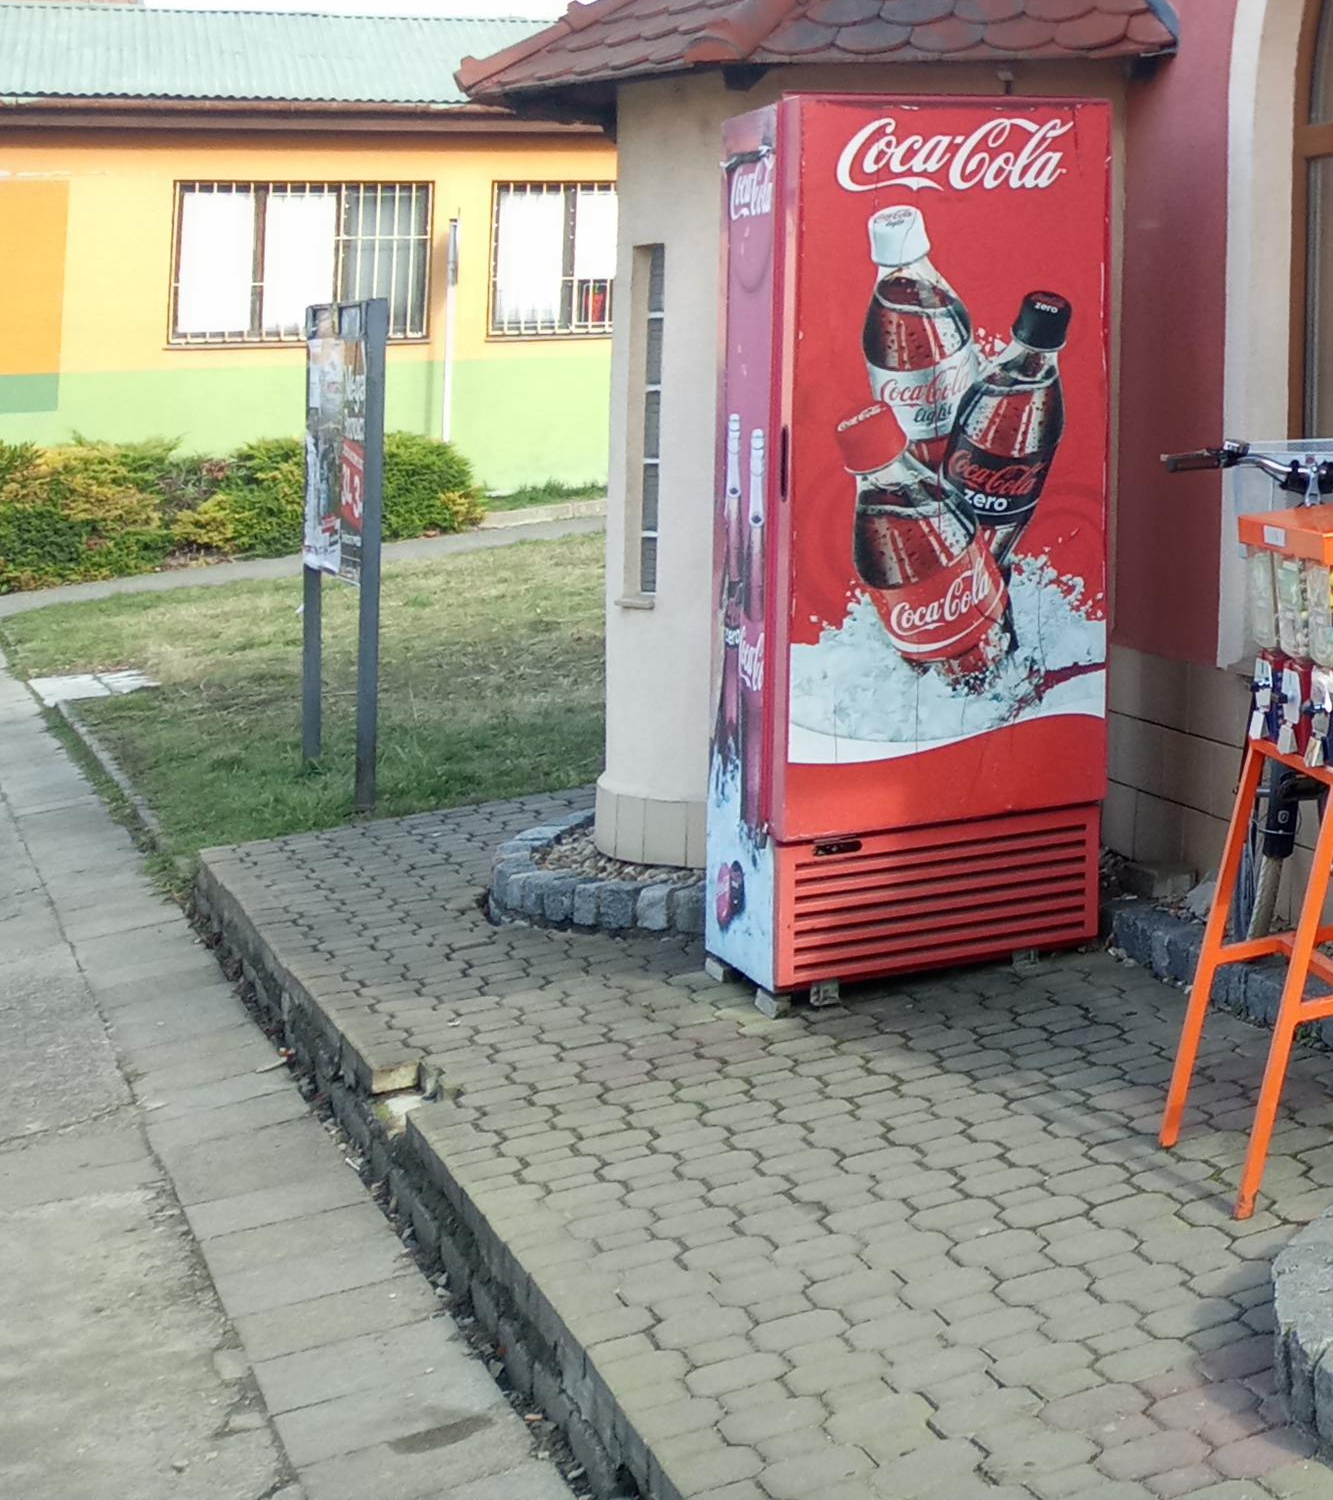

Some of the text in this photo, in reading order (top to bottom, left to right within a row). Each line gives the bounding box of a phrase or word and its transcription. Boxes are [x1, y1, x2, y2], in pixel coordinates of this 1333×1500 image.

[836, 117, 1075, 193] Coca-Cola
[1033, 301, 1059, 314] zero
[880, 359, 970, 408] Coca-Cola
[913, 403, 953, 427] light
[947, 449, 1047, 495] Coca-Cola
[963, 488, 1009, 512] zero
[890, 556, 993, 636] Coca-Cola
